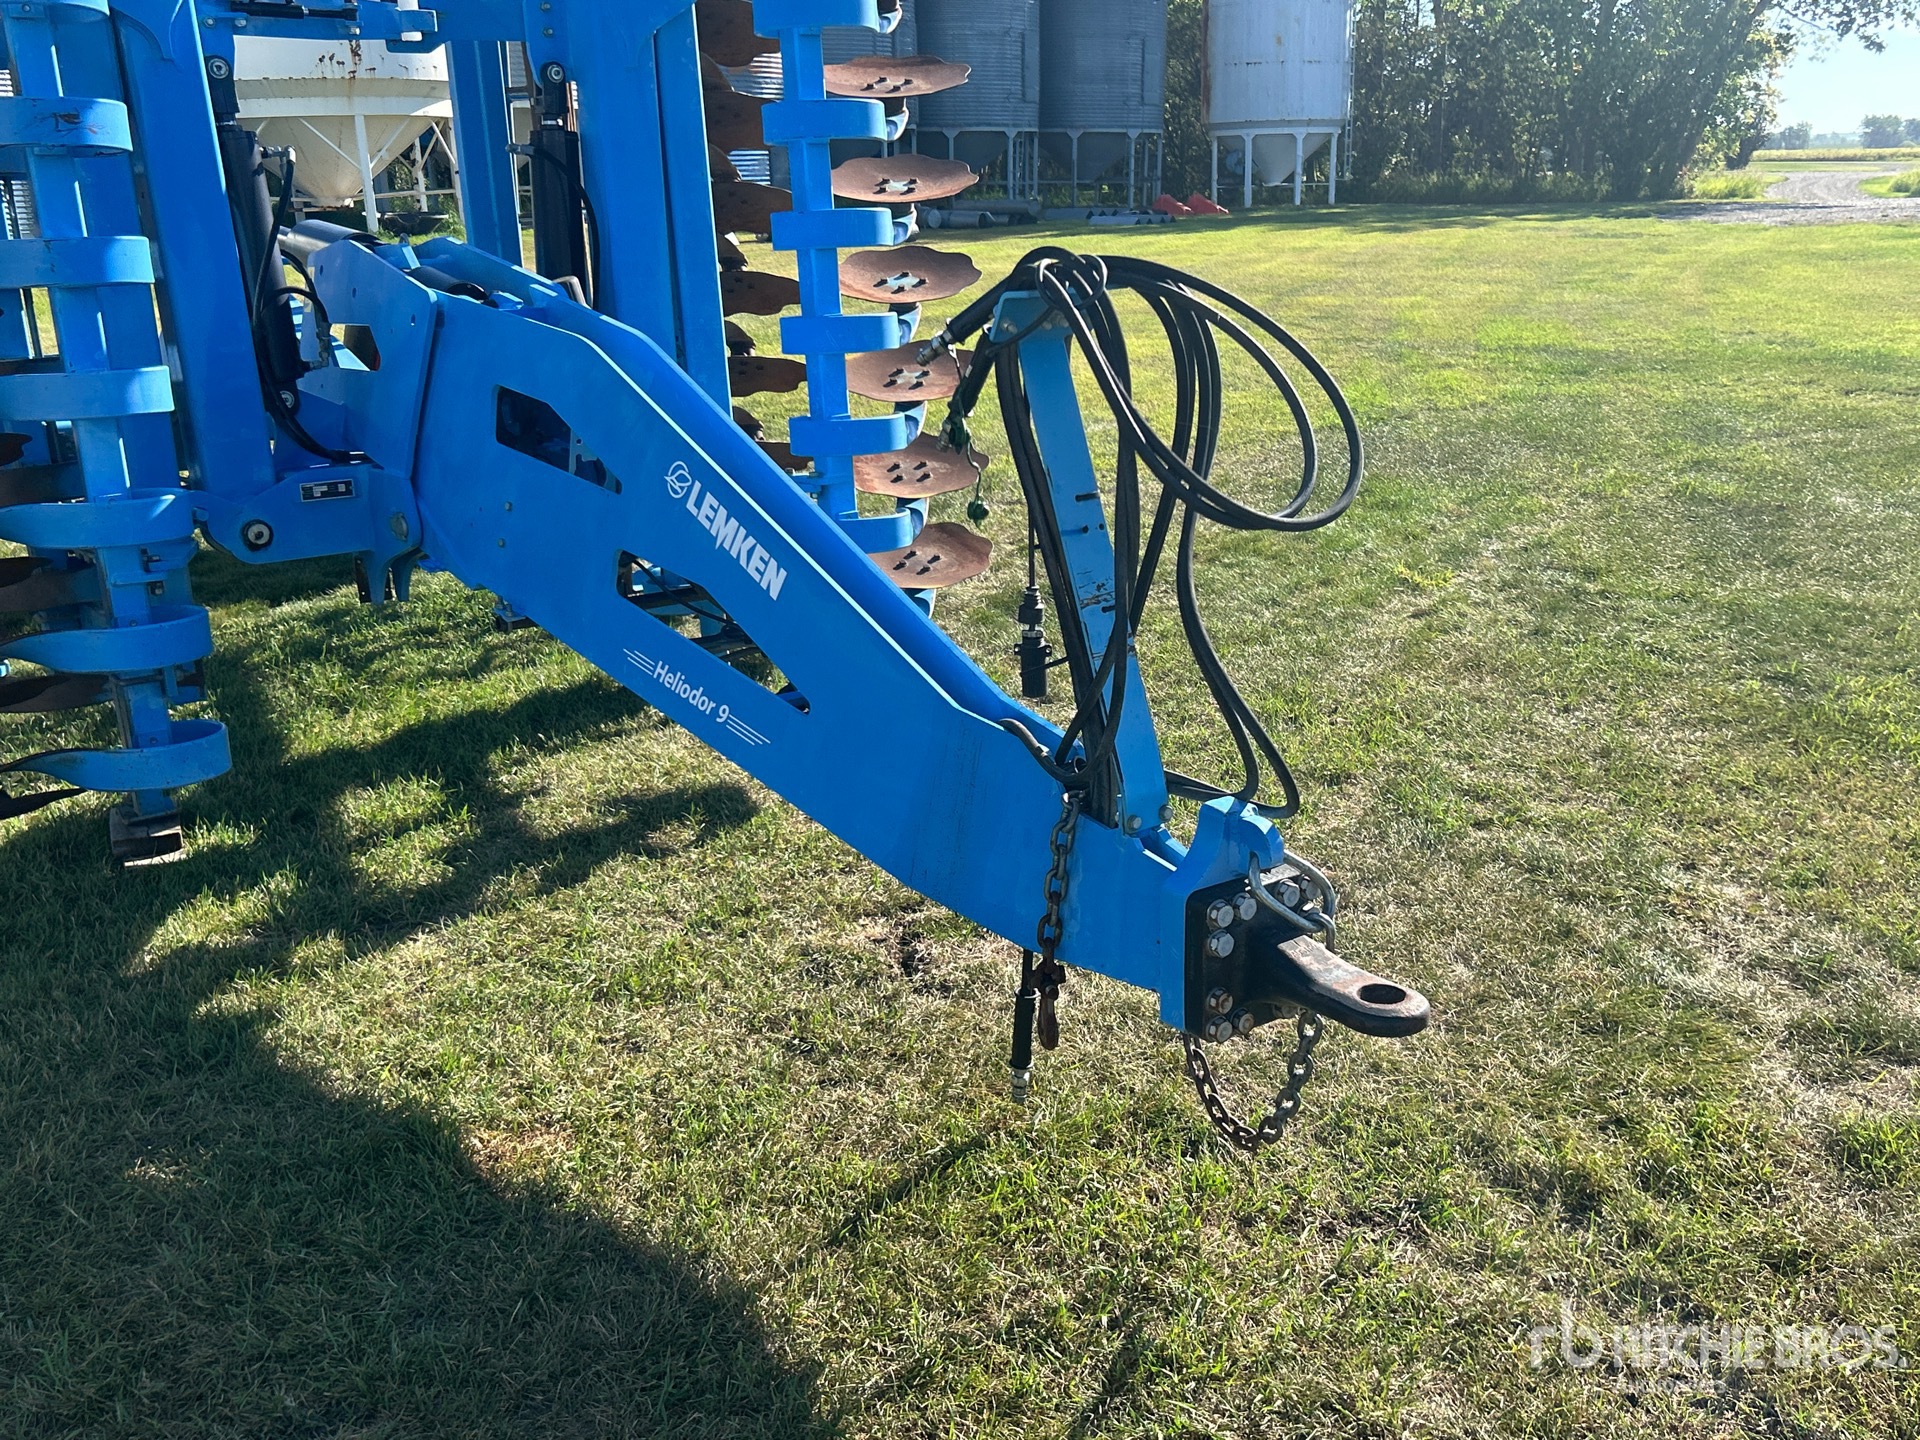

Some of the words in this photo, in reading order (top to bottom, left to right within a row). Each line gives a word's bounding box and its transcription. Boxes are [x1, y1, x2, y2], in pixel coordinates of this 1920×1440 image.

[686, 480, 787, 600] LEMKEN
[653, 661, 716, 715] Heliodor
[716, 704, 730, 723] 9
